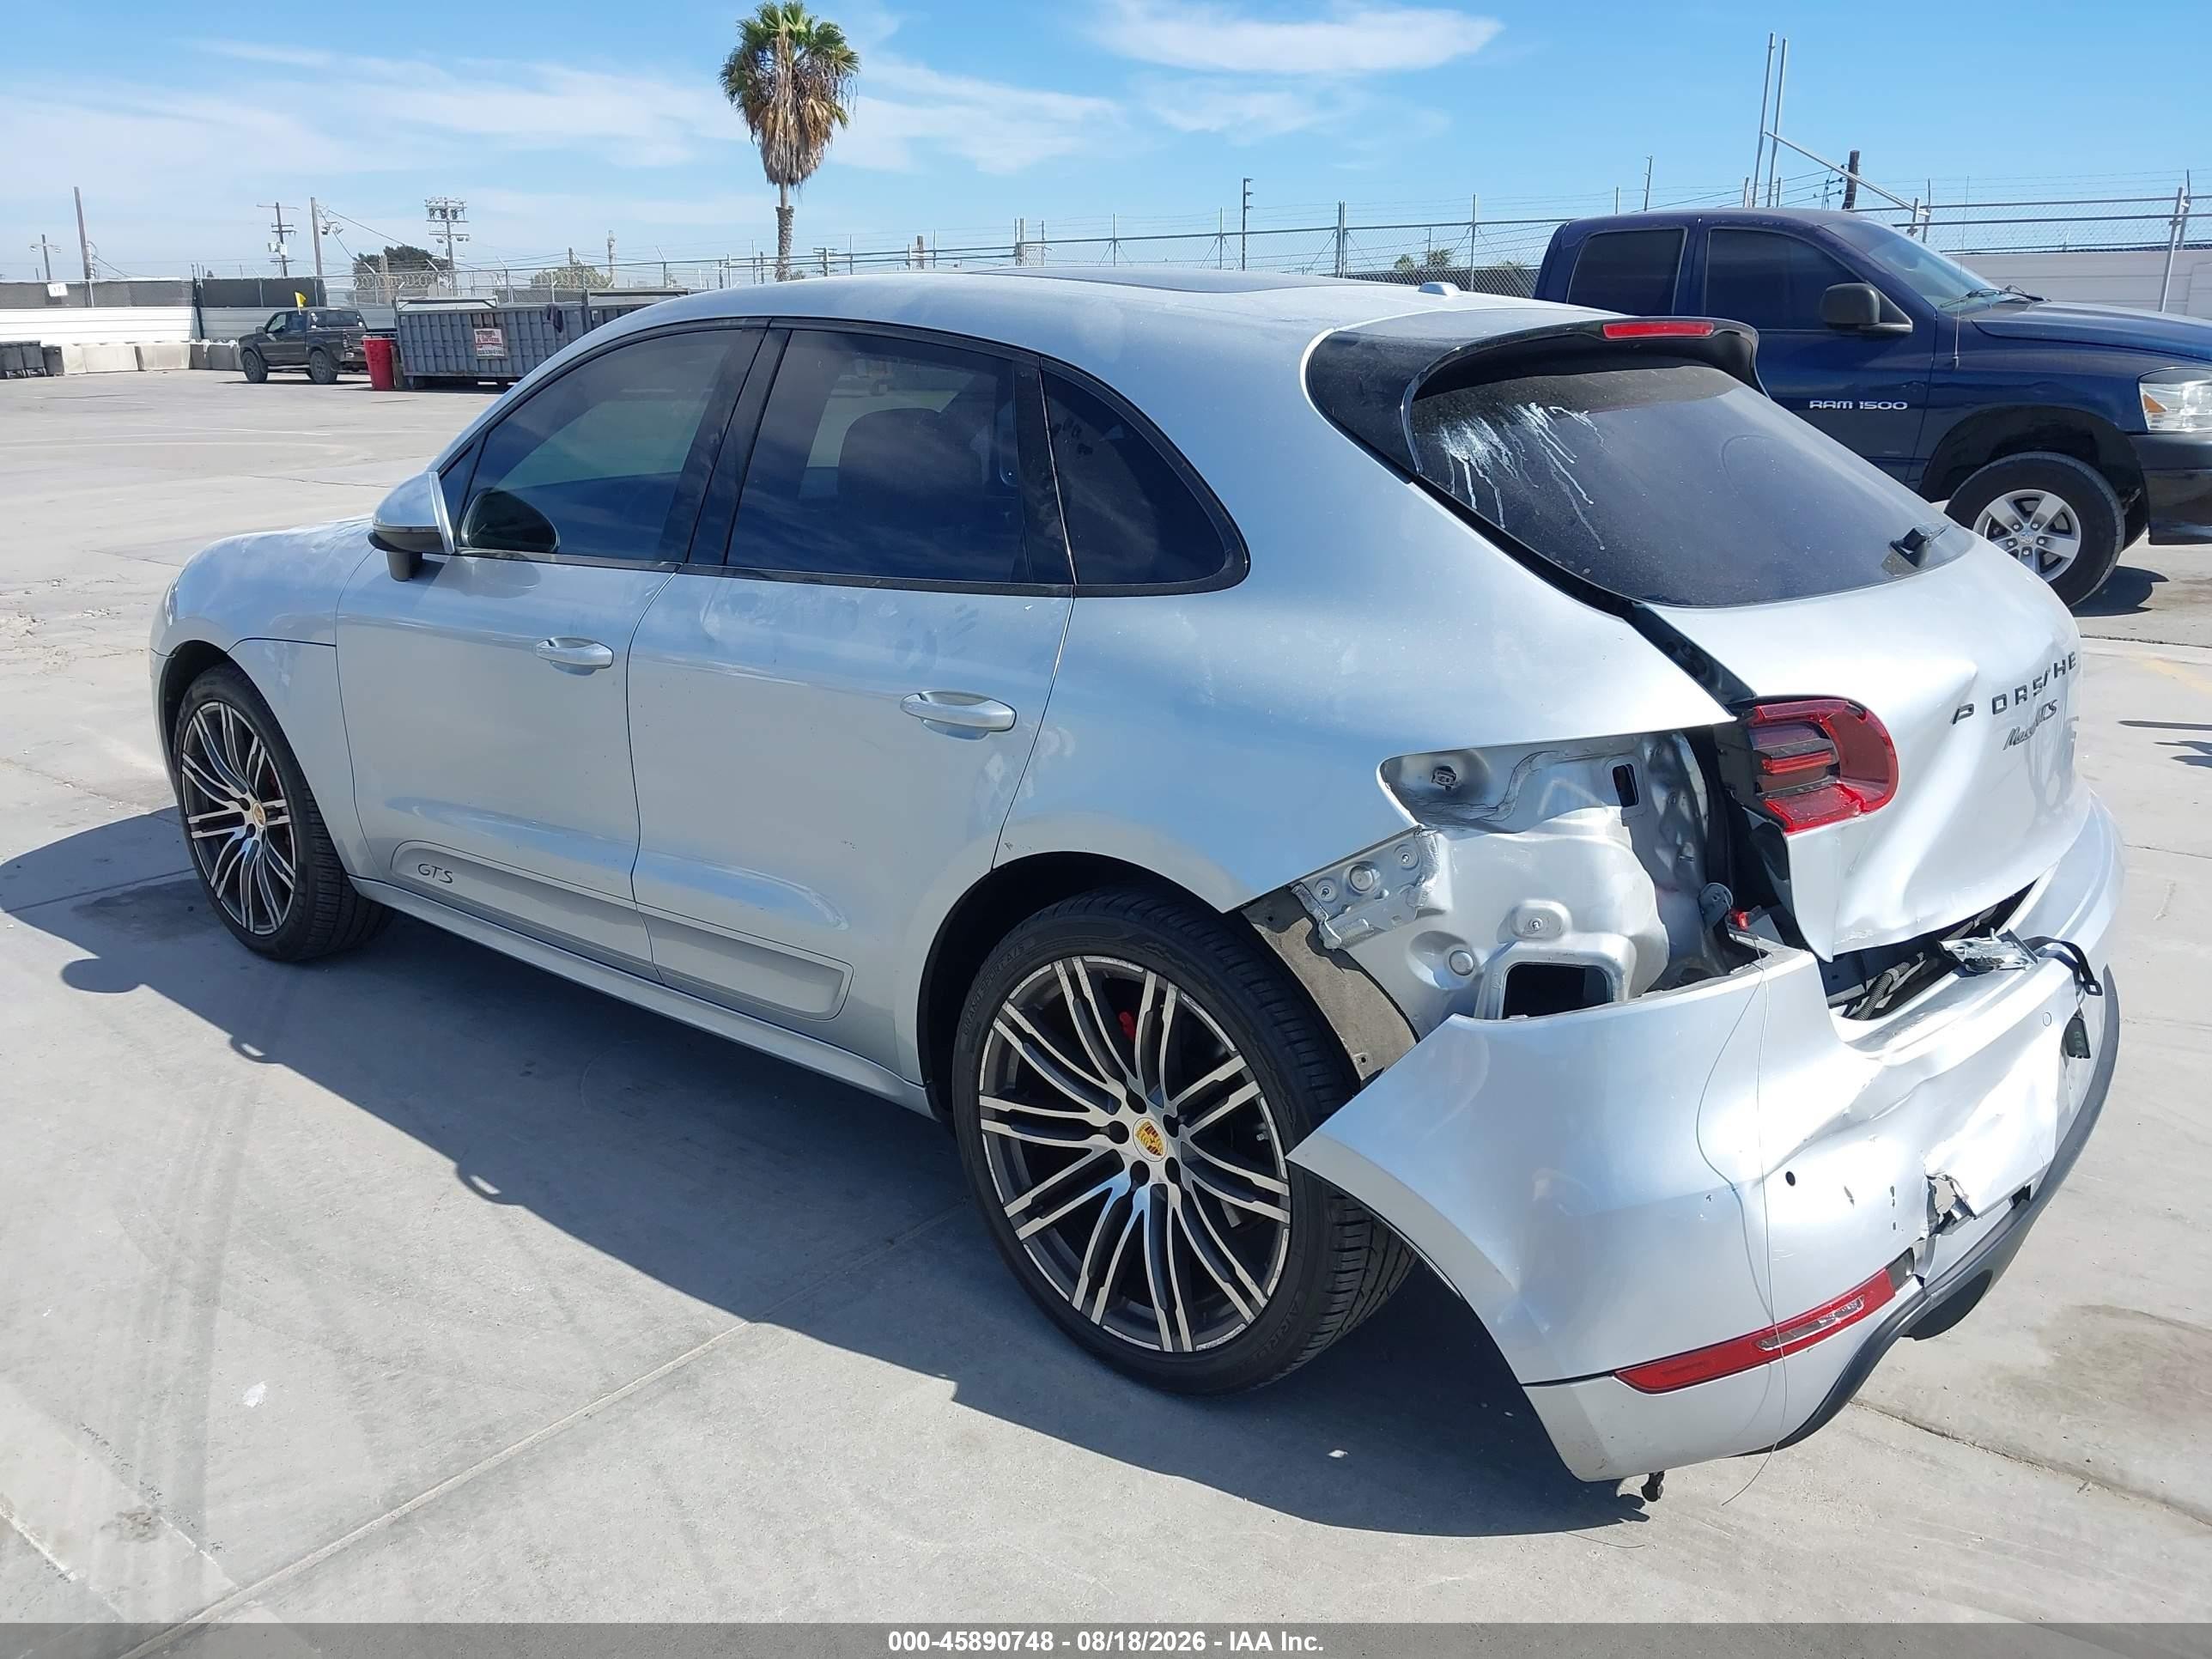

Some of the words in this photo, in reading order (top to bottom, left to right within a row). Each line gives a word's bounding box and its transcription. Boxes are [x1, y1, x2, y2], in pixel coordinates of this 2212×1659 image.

[1809, 400, 1853, 410] RAM
[1859, 401, 1908, 410] 1500
[417, 863, 453, 884] GTS
